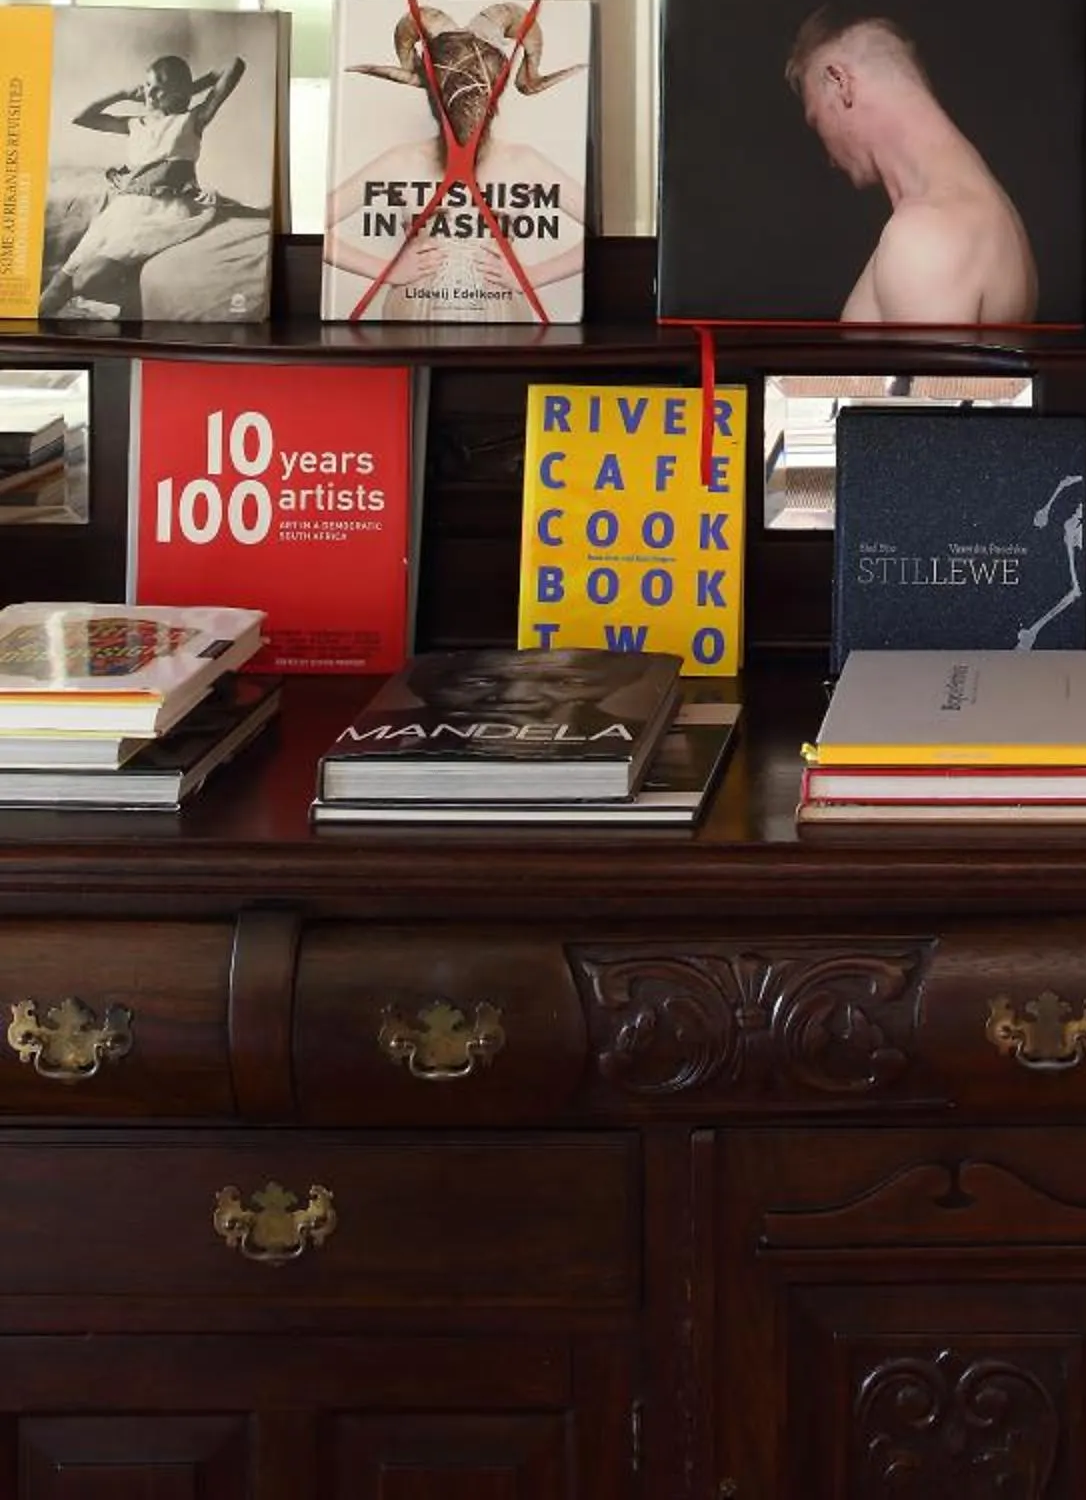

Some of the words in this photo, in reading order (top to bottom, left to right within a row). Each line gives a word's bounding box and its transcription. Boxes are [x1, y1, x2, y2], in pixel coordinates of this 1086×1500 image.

[362, 212, 397, 238] IN
[0, 236, 15, 275] SOME
[543, 395, 733, 437] RIVER
[206, 409, 274, 477] 10
[279, 450, 374, 481] years
[539, 451, 730, 493] CAFE
[156, 476, 274, 545] 100
[278, 482, 386, 512] artists
[537, 508, 729, 550] COOK
[537, 565, 727, 608] BOOK
[857, 556, 1020, 586] STILLEWE
[533, 623, 726, 665] TWO
[335, 723, 633, 743] MANDELA
